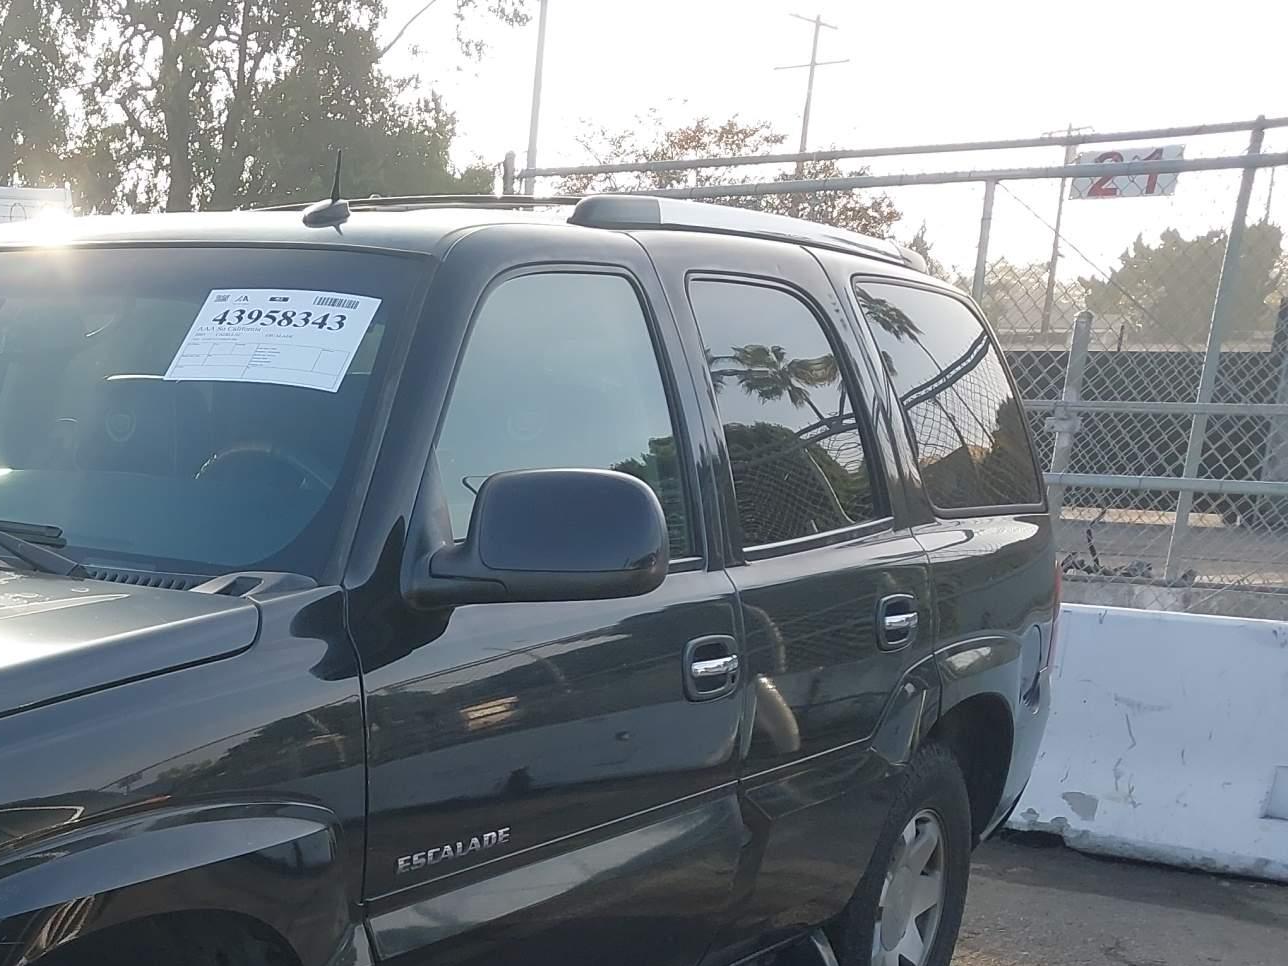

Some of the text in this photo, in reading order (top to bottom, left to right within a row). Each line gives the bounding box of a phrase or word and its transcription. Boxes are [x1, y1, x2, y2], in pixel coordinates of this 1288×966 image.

[1087, 148, 1164, 197] 21
[212, 308, 346, 331] 43958343
[396, 827, 511, 873] ESCALADE
